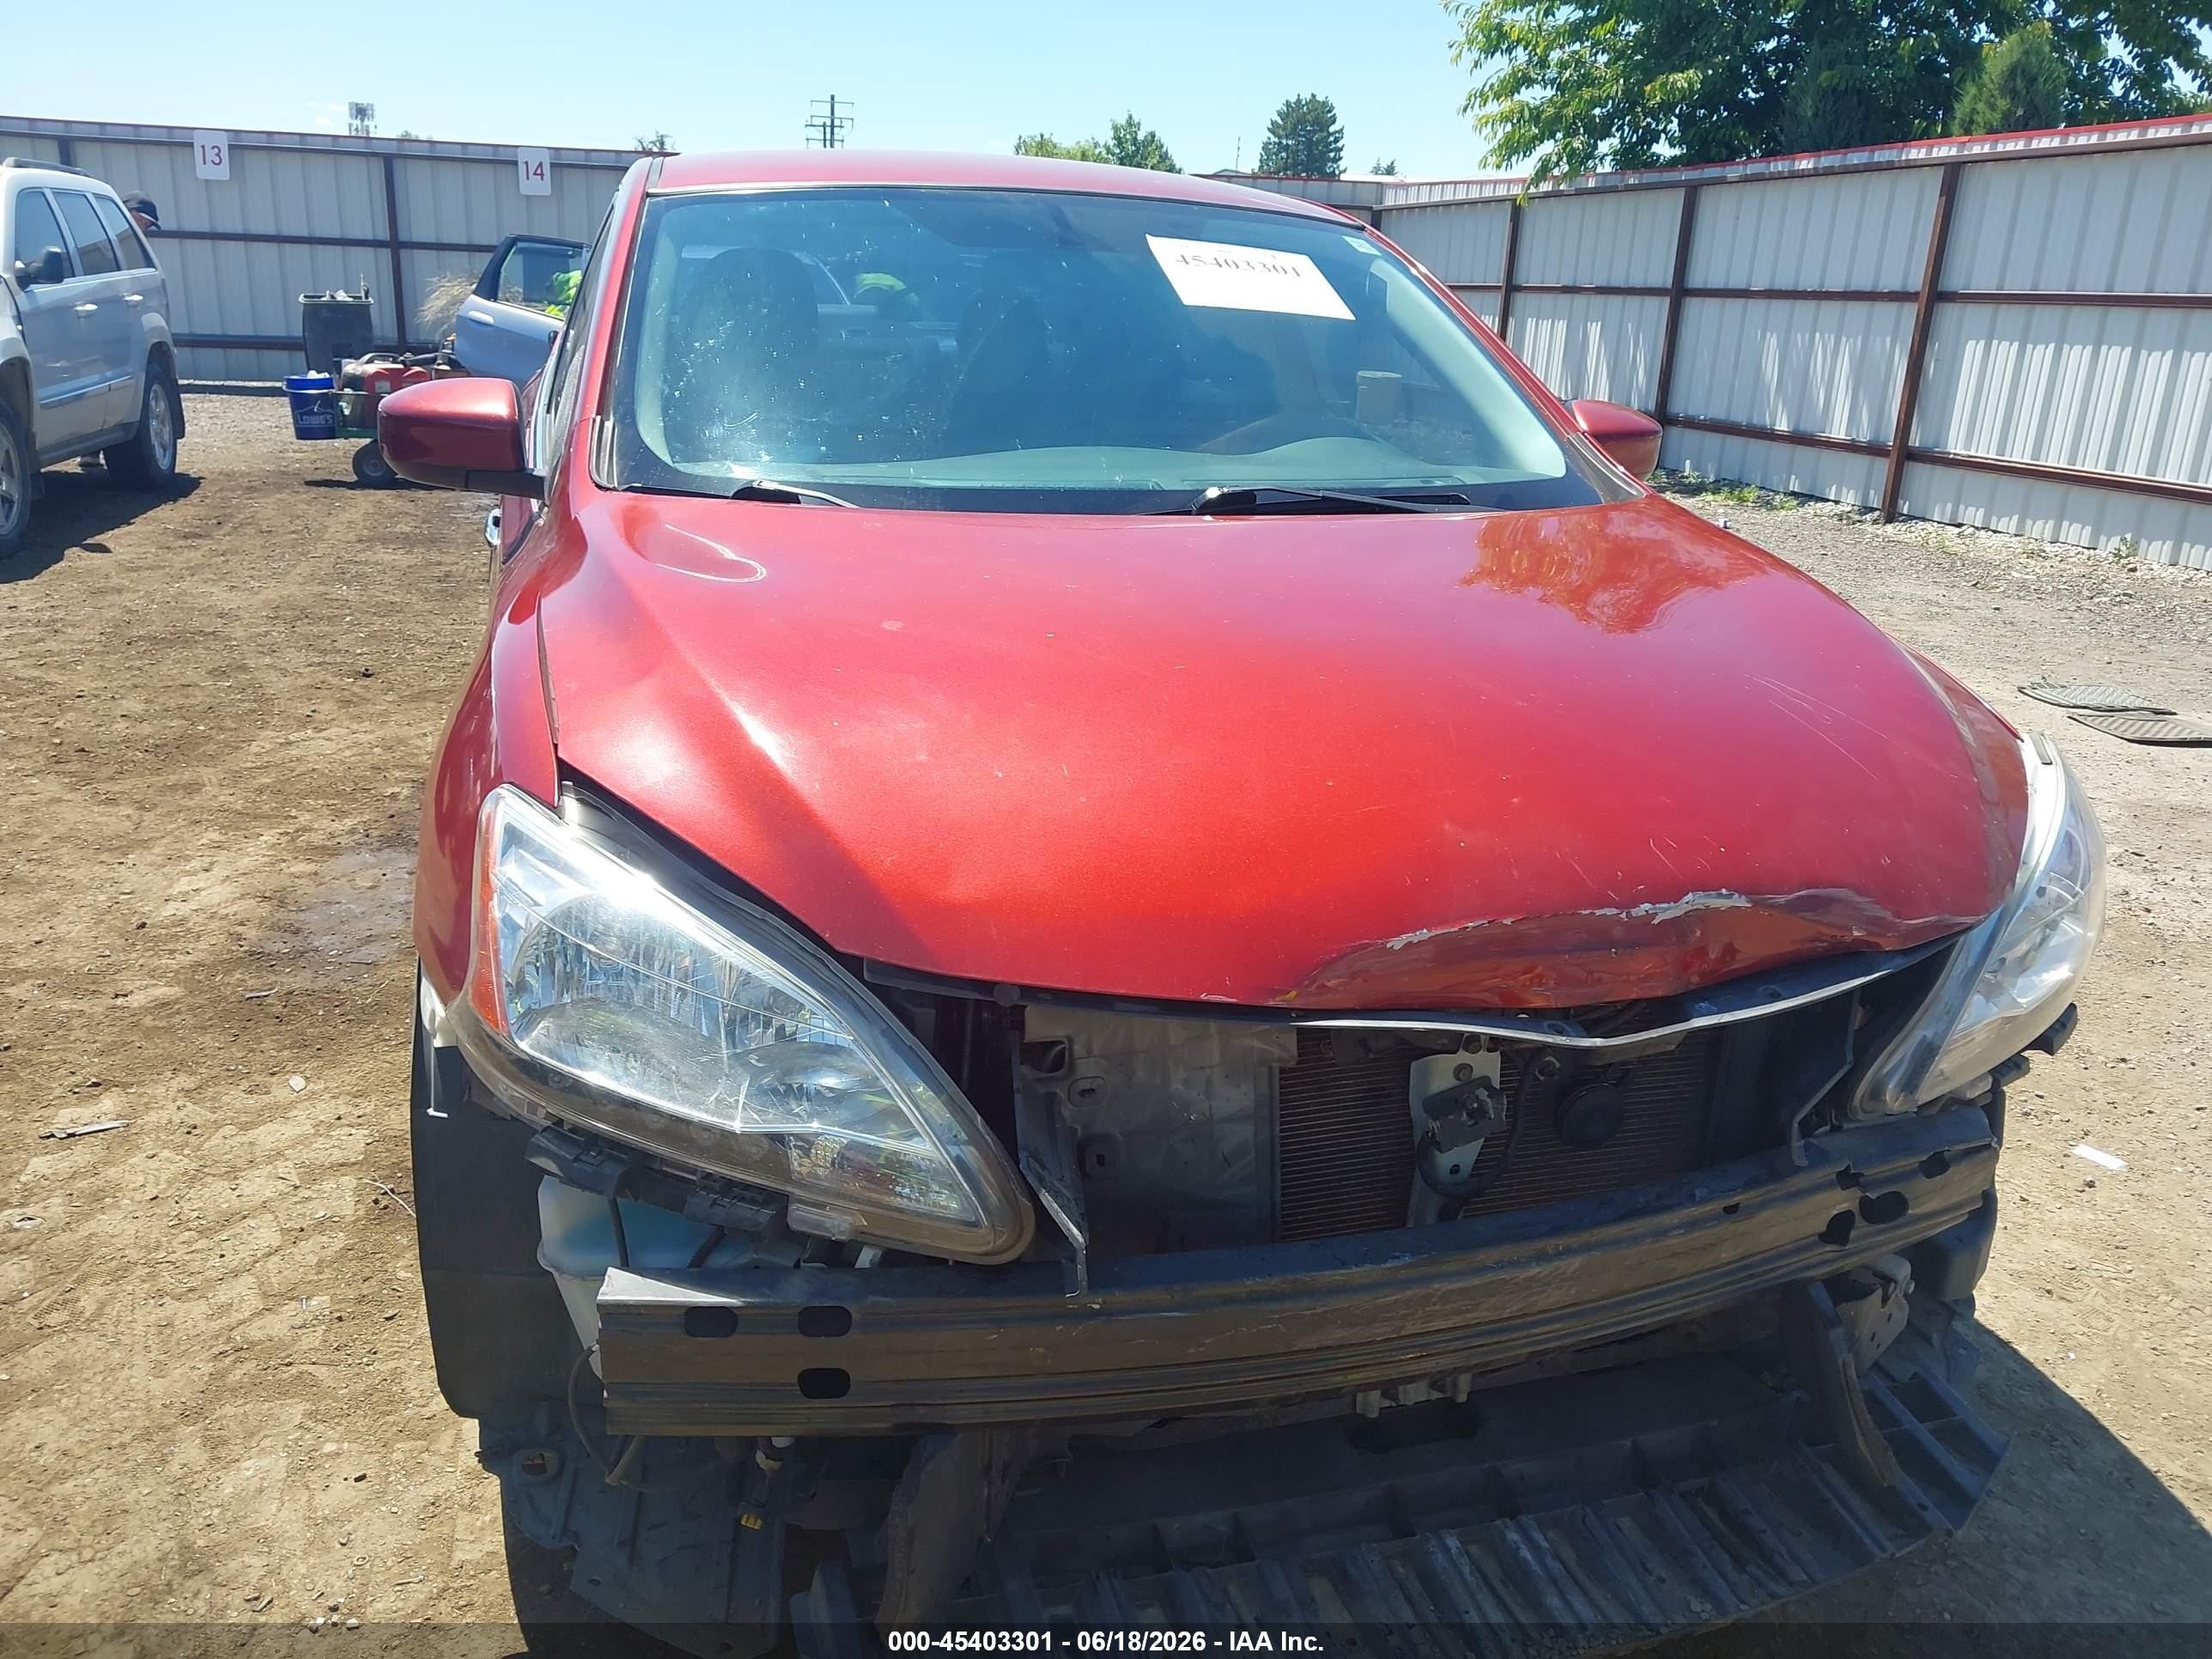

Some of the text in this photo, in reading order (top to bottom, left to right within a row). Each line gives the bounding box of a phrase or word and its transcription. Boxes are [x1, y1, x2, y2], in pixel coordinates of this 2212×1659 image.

[200, 144, 222, 166] 13
[523, 161, 544, 180] 14
[1176, 253, 1301, 277] 45403301
[297, 413, 333, 425] LOWE'S
